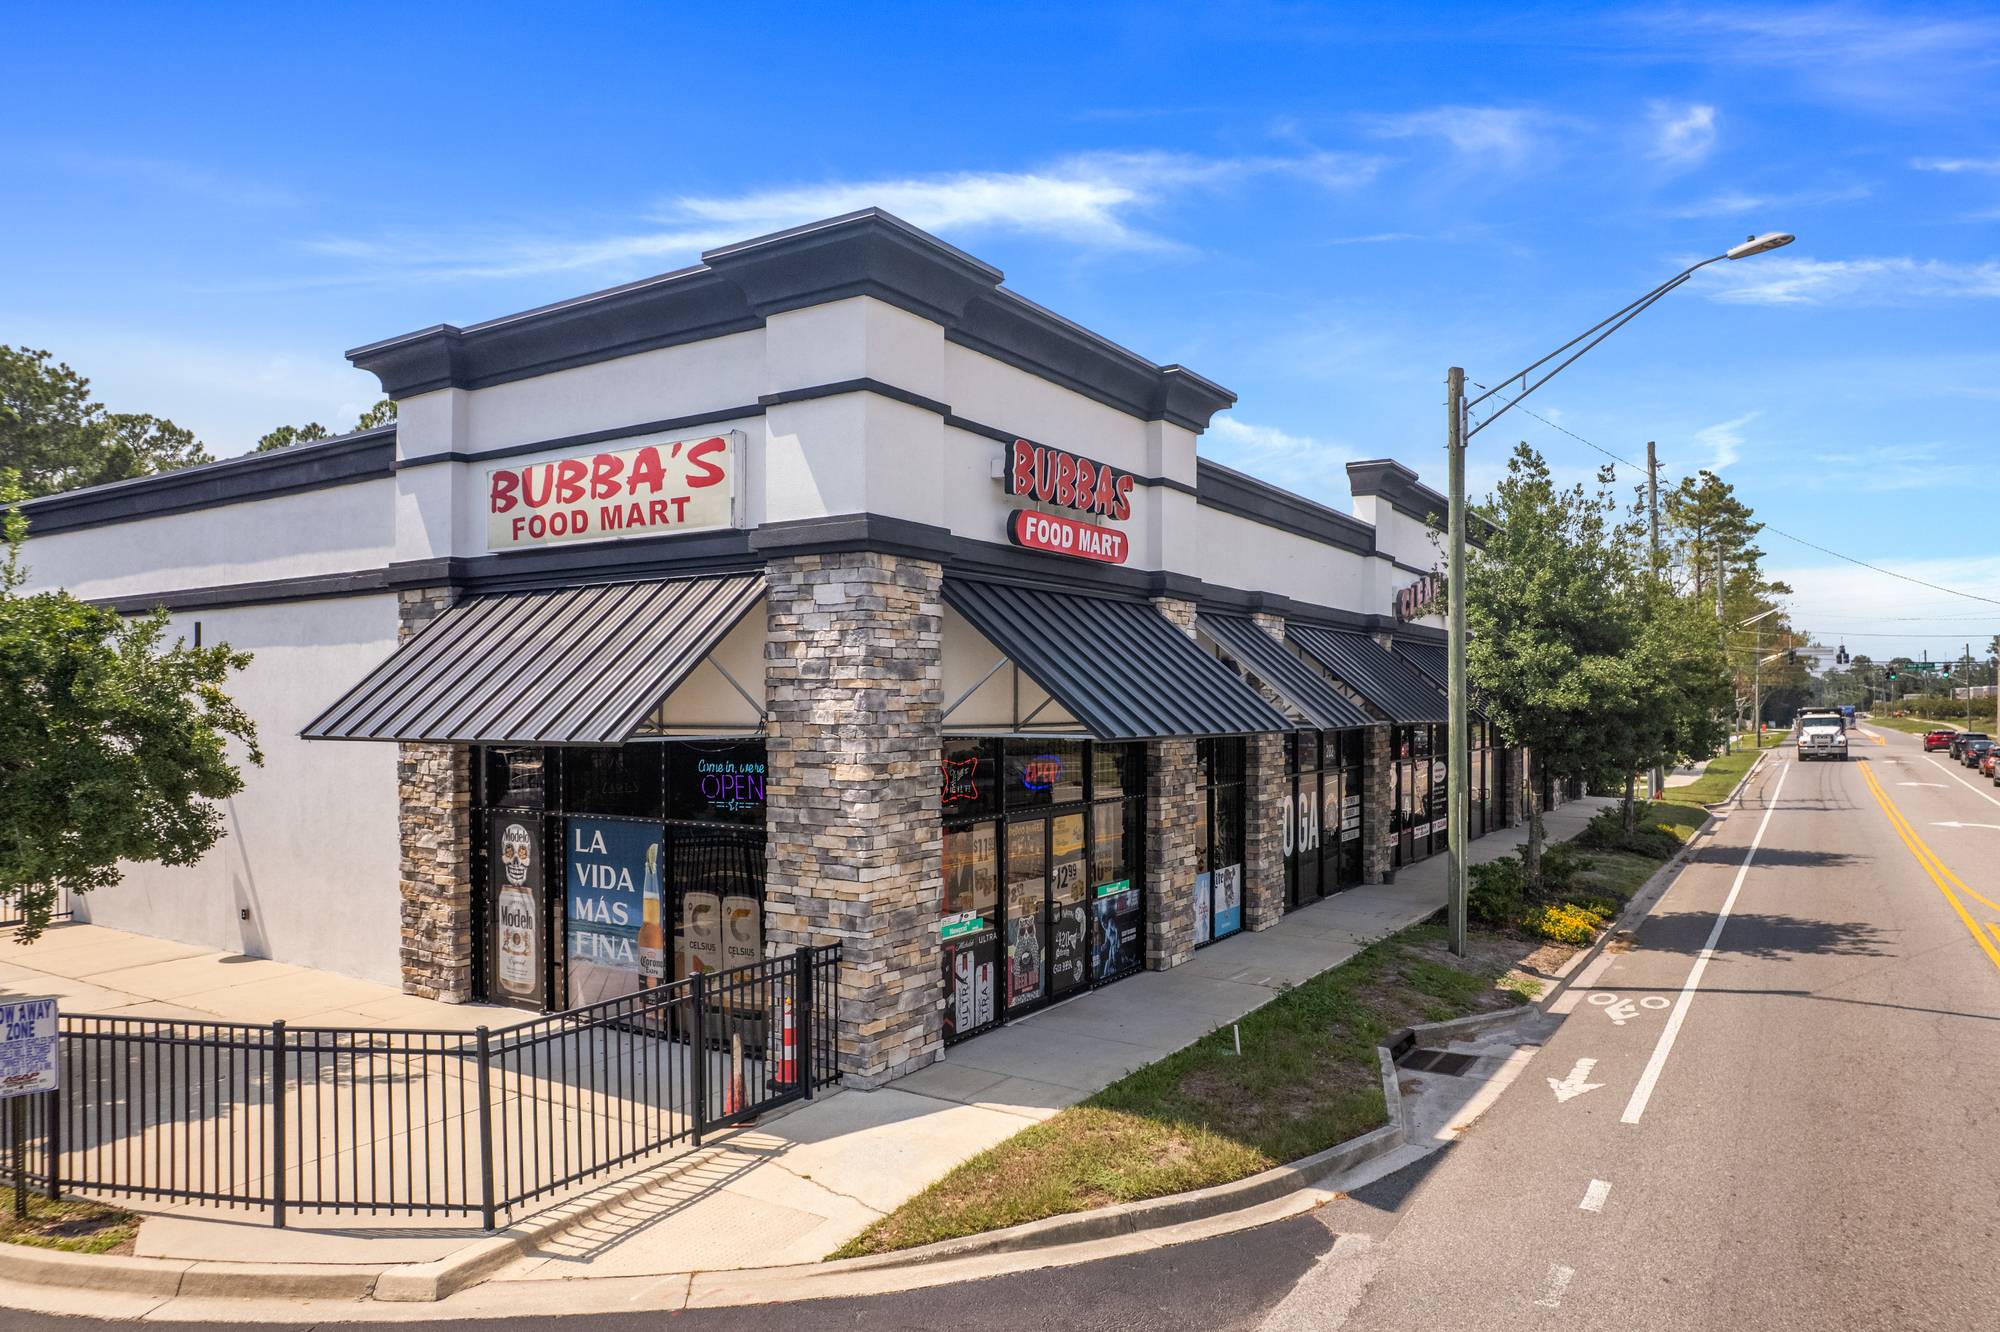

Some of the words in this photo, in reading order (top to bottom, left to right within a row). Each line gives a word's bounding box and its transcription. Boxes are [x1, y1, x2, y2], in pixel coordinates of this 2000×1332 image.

[491, 437, 726, 513] BUBBA'S
[1013, 439, 1134, 521] BUBBAS
[512, 509, 589, 541] FOOD
[600, 496, 691, 530] MART
[1025, 516, 1074, 548] FOOD
[1078, 528, 1122, 558] MART
[701, 774, 764, 800] OPEN
[1283, 791, 1320, 857] OGA
[575, 829, 608, 854] LA
[575, 862, 635, 892] VIDA
[501, 904, 533, 930] Modelo
[575, 895, 629, 926] MÁS
[575, 931, 634, 962] FINA
[689, 940, 717, 952] CELSIUS
[728, 945, 755, 957] CELSIUS
[978, 931, 998, 944] ULTRA
[0, 1006, 15, 1024] OW
[19, 1001, 52, 1020] AWAY
[961, 975, 969, 1028] ULTRA
[6, 1021, 35, 1040] ZONE
